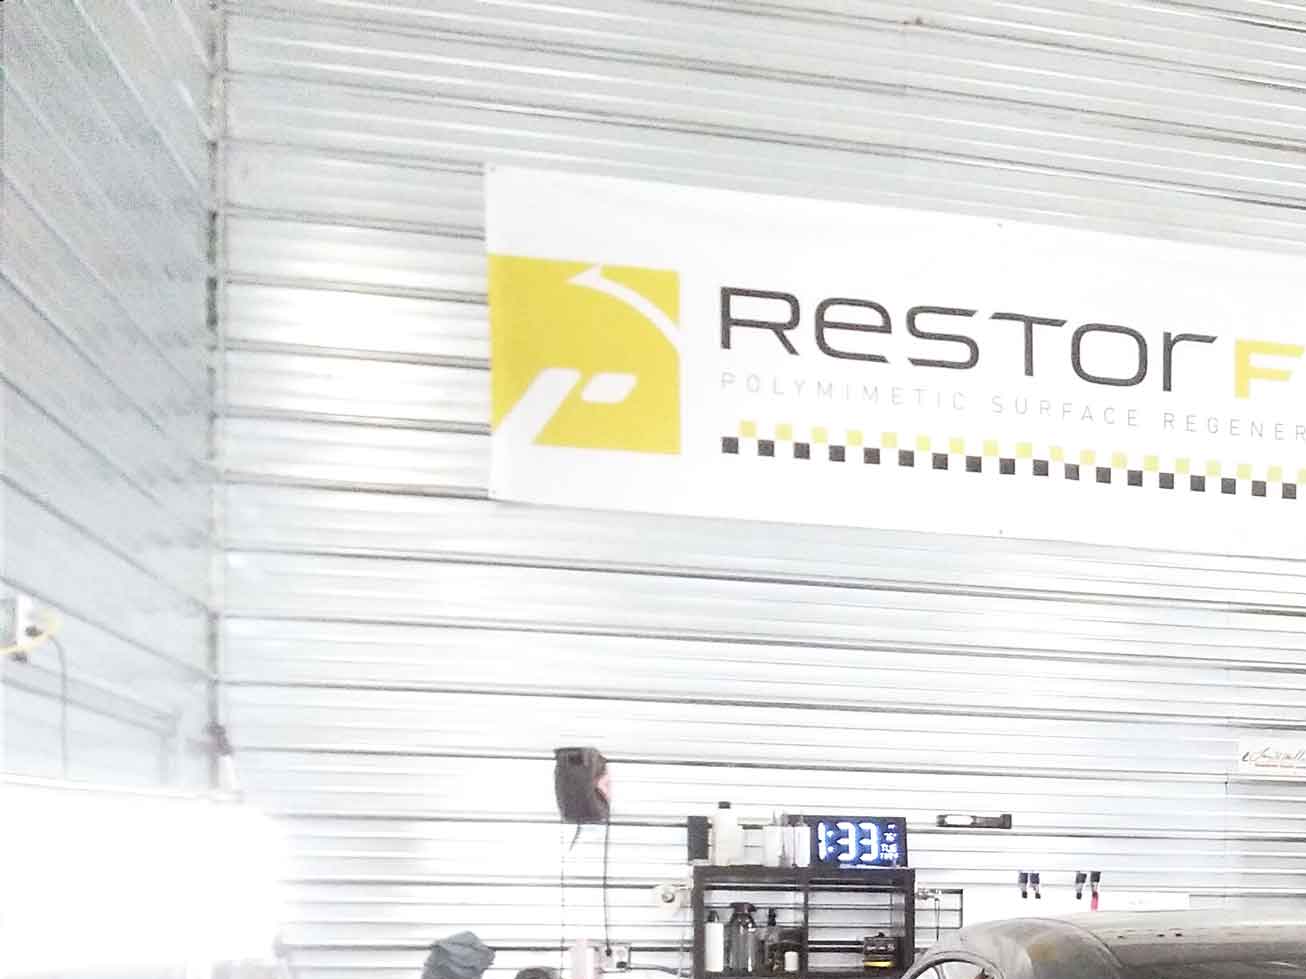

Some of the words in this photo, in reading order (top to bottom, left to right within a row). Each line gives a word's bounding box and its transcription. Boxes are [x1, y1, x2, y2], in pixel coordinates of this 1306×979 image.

[720, 372, 966, 411] POLYMIMETIC
[991, 395, 1138, 427] SURFACE
[817, 822, 878, 861] 1:33
